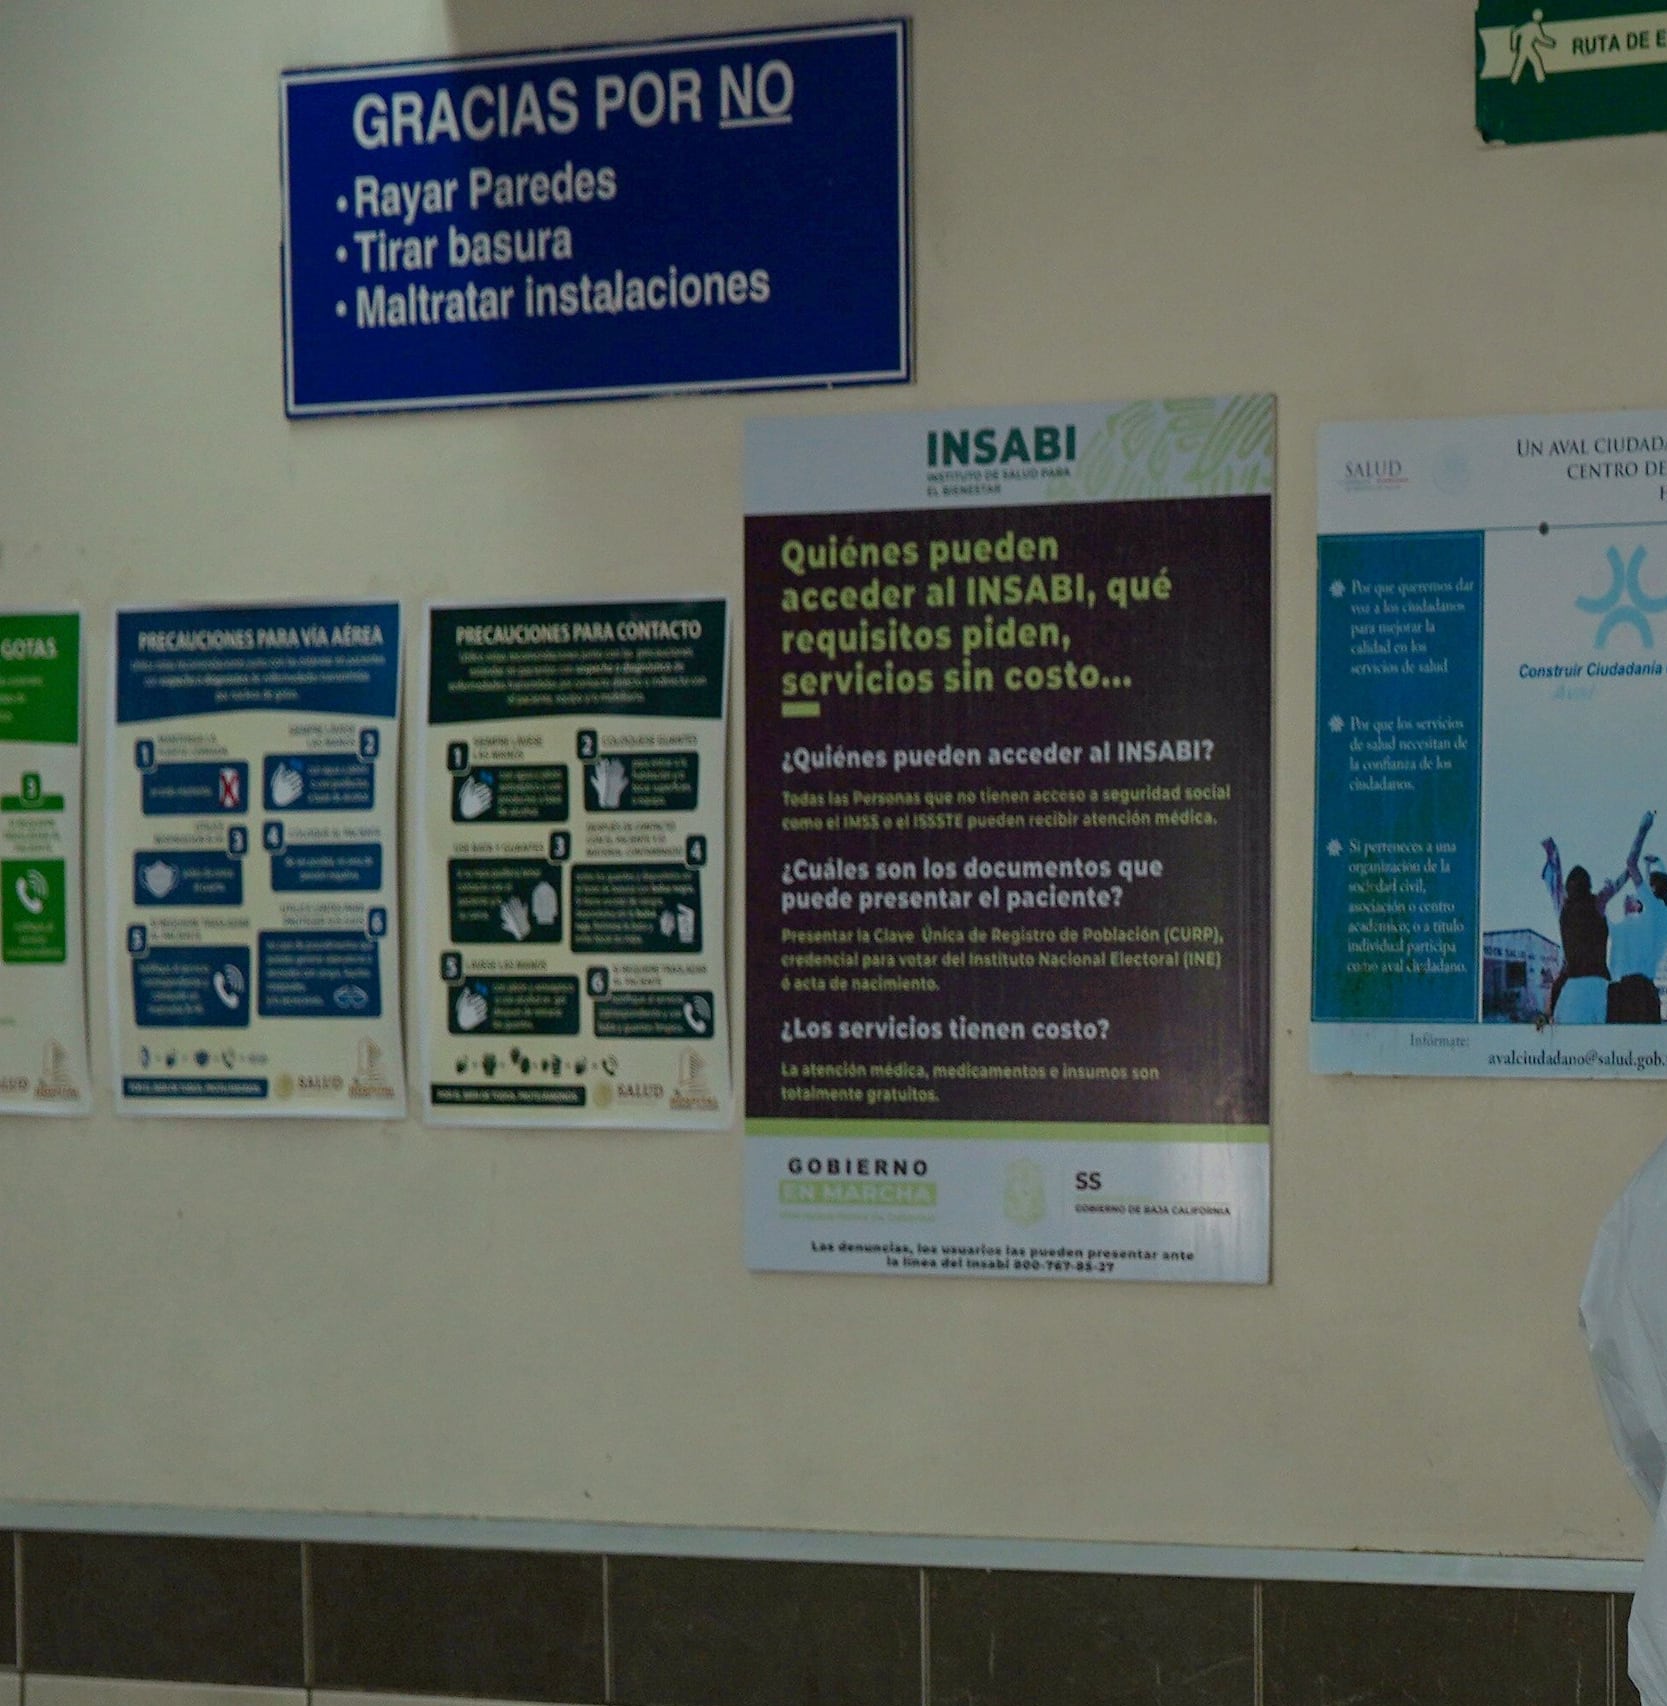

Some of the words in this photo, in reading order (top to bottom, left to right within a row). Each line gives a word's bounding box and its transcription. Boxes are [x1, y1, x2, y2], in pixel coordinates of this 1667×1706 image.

[1572, 34, 1621, 55] RUTA
[1626, 31, 1650, 51] DE
[353, 77, 579, 149] GRACIAS
[596, 68, 703, 129] POR
[720, 60, 795, 121] NO
[354, 174, 458, 225] Rayar
[470, 160, 616, 211] Paredes
[355, 229, 437, 273] Tirar
[449, 224, 572, 269] basura
[357, 278, 514, 328] Maltratar
[525, 265, 770, 319] instalaciones
[927, 425, 1076, 467] INSABI
[1549, 439, 1589, 456] AVAL
[1345, 459, 1402, 478] SALUD
[1567, 462, 1638, 480] CENTRO
[1645, 460, 1665, 477] DE
[781, 535, 920, 576] Quiénes
[929, 531, 1059, 572] pueden
[781, 579, 916, 613] acceder
[926, 576, 956, 607] al
[966, 574, 1097, 610] INSABI,
[1107, 567, 1173, 608] qué
[138, 628, 254, 653] PRECAUCIONES
[256, 626, 298, 650] PARA
[455, 622, 571, 646] PRECAUCIONES
[573, 620, 615, 643] PARA
[616, 619, 702, 642] CONTACTO
[782, 618, 951, 660] requisitos
[963, 615, 1071, 656] piden,
[0, 637, 58, 660] GOTAS
[782, 660, 934, 696] servicios
[944, 658, 994, 693] sin
[1004, 660, 1132, 691] costo...
[1519, 663, 1582, 679] Construir
[363, 734, 375, 755] 2
[454, 747, 462, 766] 1
[582, 735, 593, 756] 2
[781, 743, 888, 773] ¿Quiénes
[893, 744, 982, 772] pueden
[987, 741, 1084, 766] acceder
[1089, 740, 1111, 765] al
[1117, 738, 1215, 764] INSABI?
[782, 789, 825, 807] Todas
[828, 790, 850, 807] las
[852, 790, 921, 807] Personas
[924, 791, 954, 809] que
[956, 790, 977, 805] no
[979, 786, 1029, 804] tienen
[1033, 789, 1086, 803] acceso
[1089, 789, 1099, 803] a
[1102, 784, 1182, 806] seguridad
[1184, 784, 1232, 802] social
[781, 817, 824, 832] como
[826, 814, 841, 832] el
[843, 814, 881, 831] IMSS
[883, 816, 893, 831] o
[896, 813, 910, 831] el
[966, 811, 1025, 832] pueden
[1029, 810, 1078, 828] recibir
[1082, 810, 1151, 828] atención
[781, 857, 870, 885] ¿Cuáles
[875, 861, 917, 880] son
[923, 856, 957, 880] los
[963, 856, 1112, 880] documentos
[1118, 859, 1164, 883] que
[781, 886, 852, 914] puede
[858, 888, 973, 914] presentar
[978, 885, 1000, 909] el
[1006, 882, 1123, 914] paciente?
[781, 926, 853, 944] Presentar
[856, 926, 870, 943] la
[873, 926, 916, 944] Clave
[967, 926, 988, 943] de
[991, 926, 1057, 946] Registro
[1060, 926, 1079, 943] de
[1082, 926, 1160, 944] Población
[781, 951, 859, 968] credencial
[862, 953, 896, 969] para
[899, 952, 937, 968] votar
[941, 951, 966, 967] del
[968, 950, 1035, 967] Instituto
[1038, 950, 1106, 967] Nacional
[1109, 950, 1179, 967] Electoral
[794, 977, 826, 991] acta
[829, 975, 849, 991] de
[780, 1017, 833, 1042] ¿Los
[838, 1015, 943, 1040] servicios
[948, 1015, 1026, 1040] tienen
[1032, 1018, 1110, 1041] costo?
[781, 1061, 799, 1078] La
[801, 1060, 867, 1078] atención
[932, 1061, 1047, 1081] medicamentos
[1050, 1066, 1060, 1080] e
[1062, 1063, 1128, 1081] insumos
[1131, 1065, 1159, 1081] son
[781, 1085, 864, 1102] totalmente
[788, 1158, 928, 1176] GOBIERNO
[1075, 1172, 1102, 1190] SS
